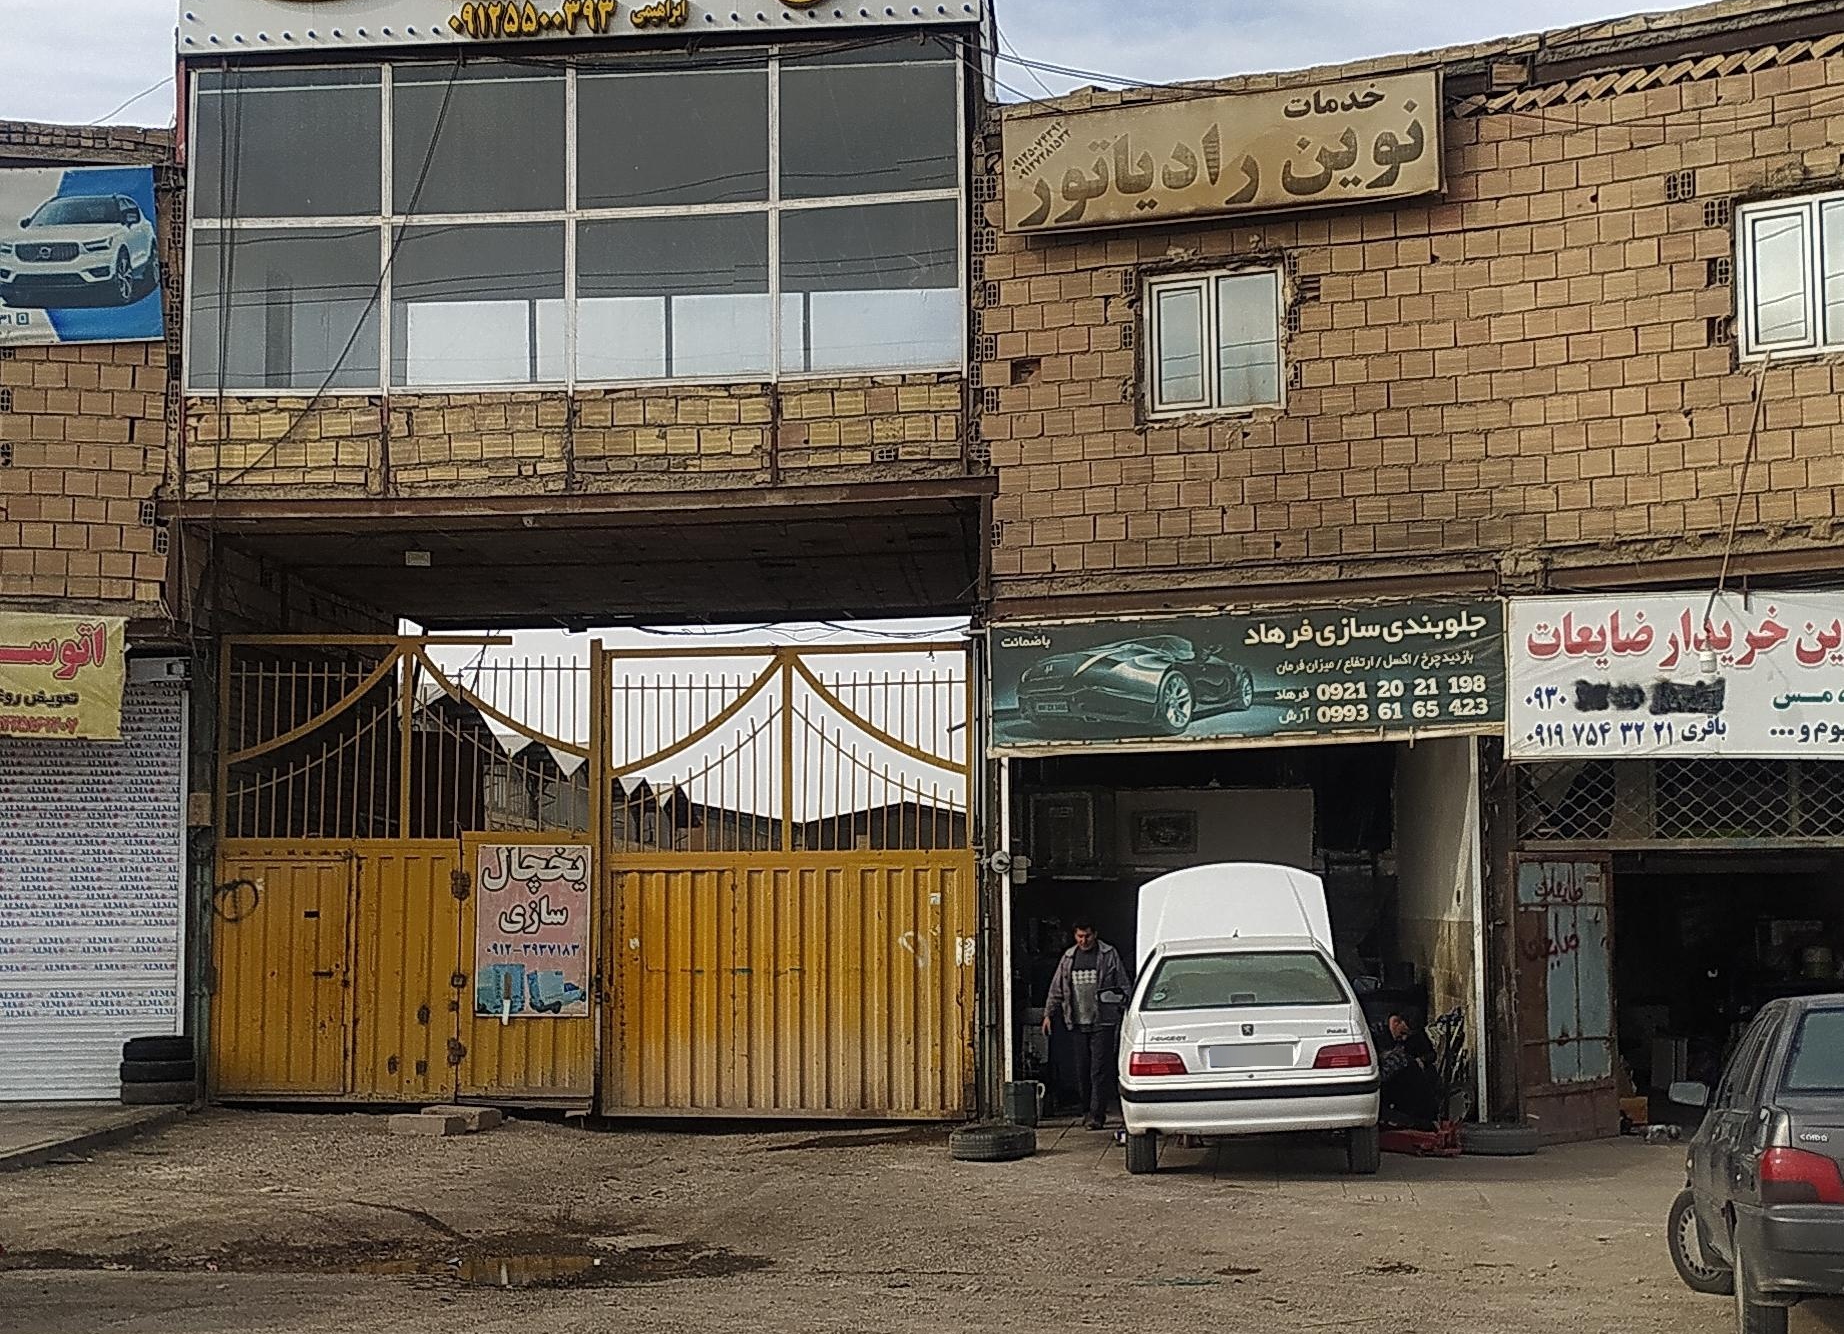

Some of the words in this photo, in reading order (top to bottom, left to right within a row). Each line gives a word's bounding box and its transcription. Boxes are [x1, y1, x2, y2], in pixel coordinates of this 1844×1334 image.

[1283, 82, 1387, 119] خدمات
[1281, 98, 1426, 197] نوین
[1018, 122, 1262, 227] رادیاتور
[1244, 618, 1315, 650] فرهاد
[1315, 616, 1382, 648] سازی
[1381, 610, 1488, 643] جلوبندی
[1526, 609, 1656, 668] ضایعات
[1657, 605, 1790, 670] خریدار
[0, 621, 107, 681] اتوس
[1383, 652, 1411, 668] اکسل
[1421, 652, 1440, 669] چرخ
[1276, 659, 1305, 675] فرمان
[1306, 659, 1335, 673] میزان
[1343, 656, 1374, 674] ارتفاع
[1316, 680, 1368, 702] 0921
[1376, 679, 1405, 699] 20
[1413, 677, 1440, 697] 21
[1448, 674, 1487, 694] 198
[1274, 688, 1311, 703] فرهاد
[1525, 685, 1568, 710] ۰۹۳۰
[1277, 706, 1311, 725] آرش
[1316, 703, 1370, 724] 0993
[1377, 701, 1404, 720] 61
[1411, 699, 1440, 719] 65
[1448, 697, 1489, 717] 423
[1525, 722, 1566, 747] ۰۹۱۹
[1571, 721, 1614, 747] ۷۵۴
[1619, 721, 1647, 747] ۳۲
[1653, 720, 1675, 747] ۲۱
[1680, 714, 1728, 743] باقری
[481, 846, 588, 895] یخچال
[498, 894, 569, 935] سازی
